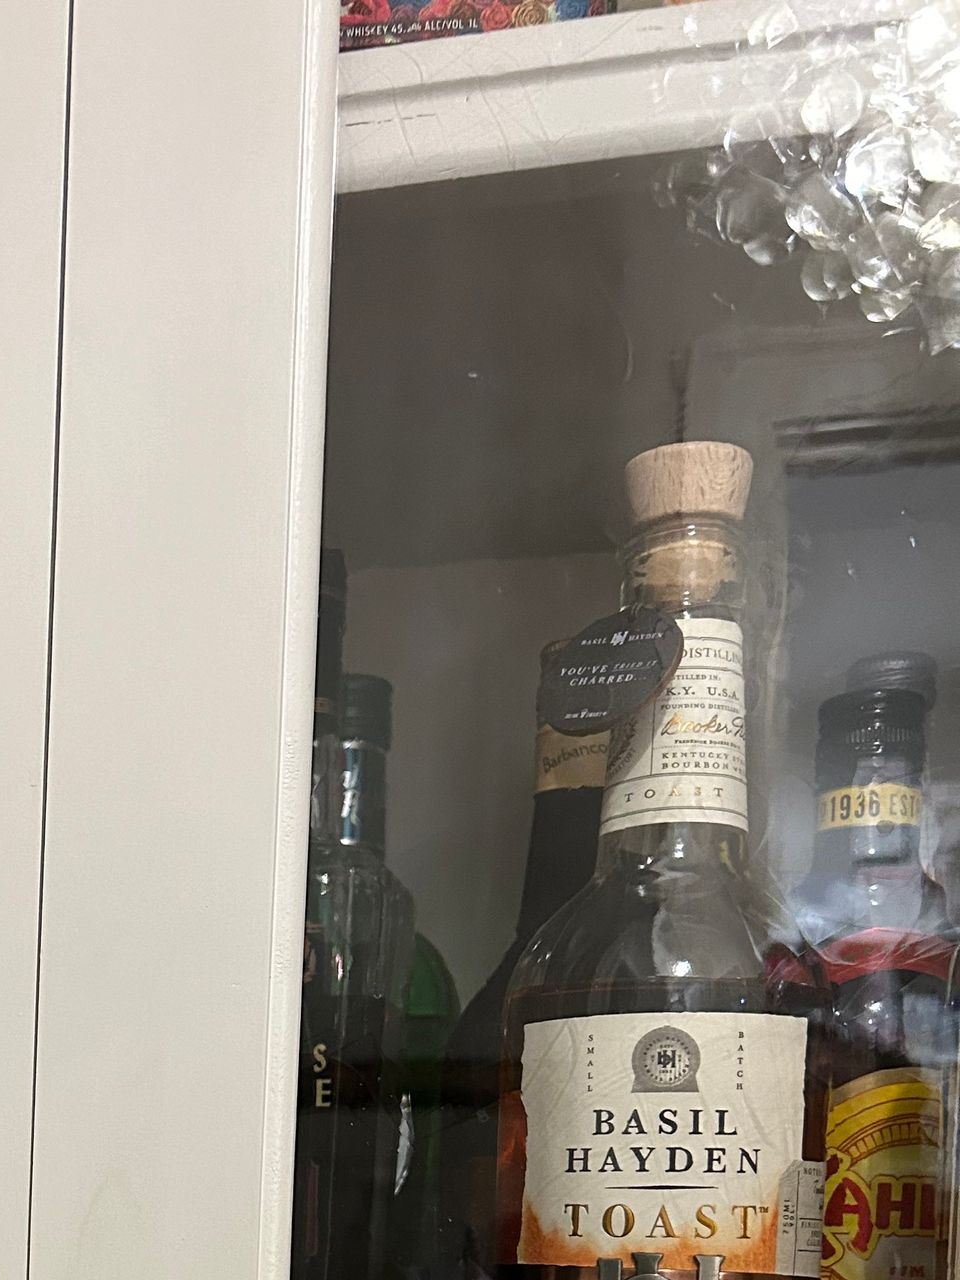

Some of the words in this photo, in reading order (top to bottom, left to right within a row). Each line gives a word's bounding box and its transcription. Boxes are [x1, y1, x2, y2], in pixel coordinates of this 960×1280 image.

[346, 24, 388, 37] WHISKEY
[424, 19, 464, 31] ALC/VOL
[560, 665, 609, 676] YOU'VE
[665, 686, 696, 697] K.Y.
[660, 703, 706, 711] FOUNDING
[661, 751, 730, 760] KENTUCKY
[661, 761, 730, 771] BOURBON
[624, 787, 724, 803] TOAST
[830, 791, 880, 823] 1936
[592, 1108, 737, 1136] BASIL
[564, 1147, 761, 1174] HAYDEN
[564, 1203, 759, 1240] TOAST
